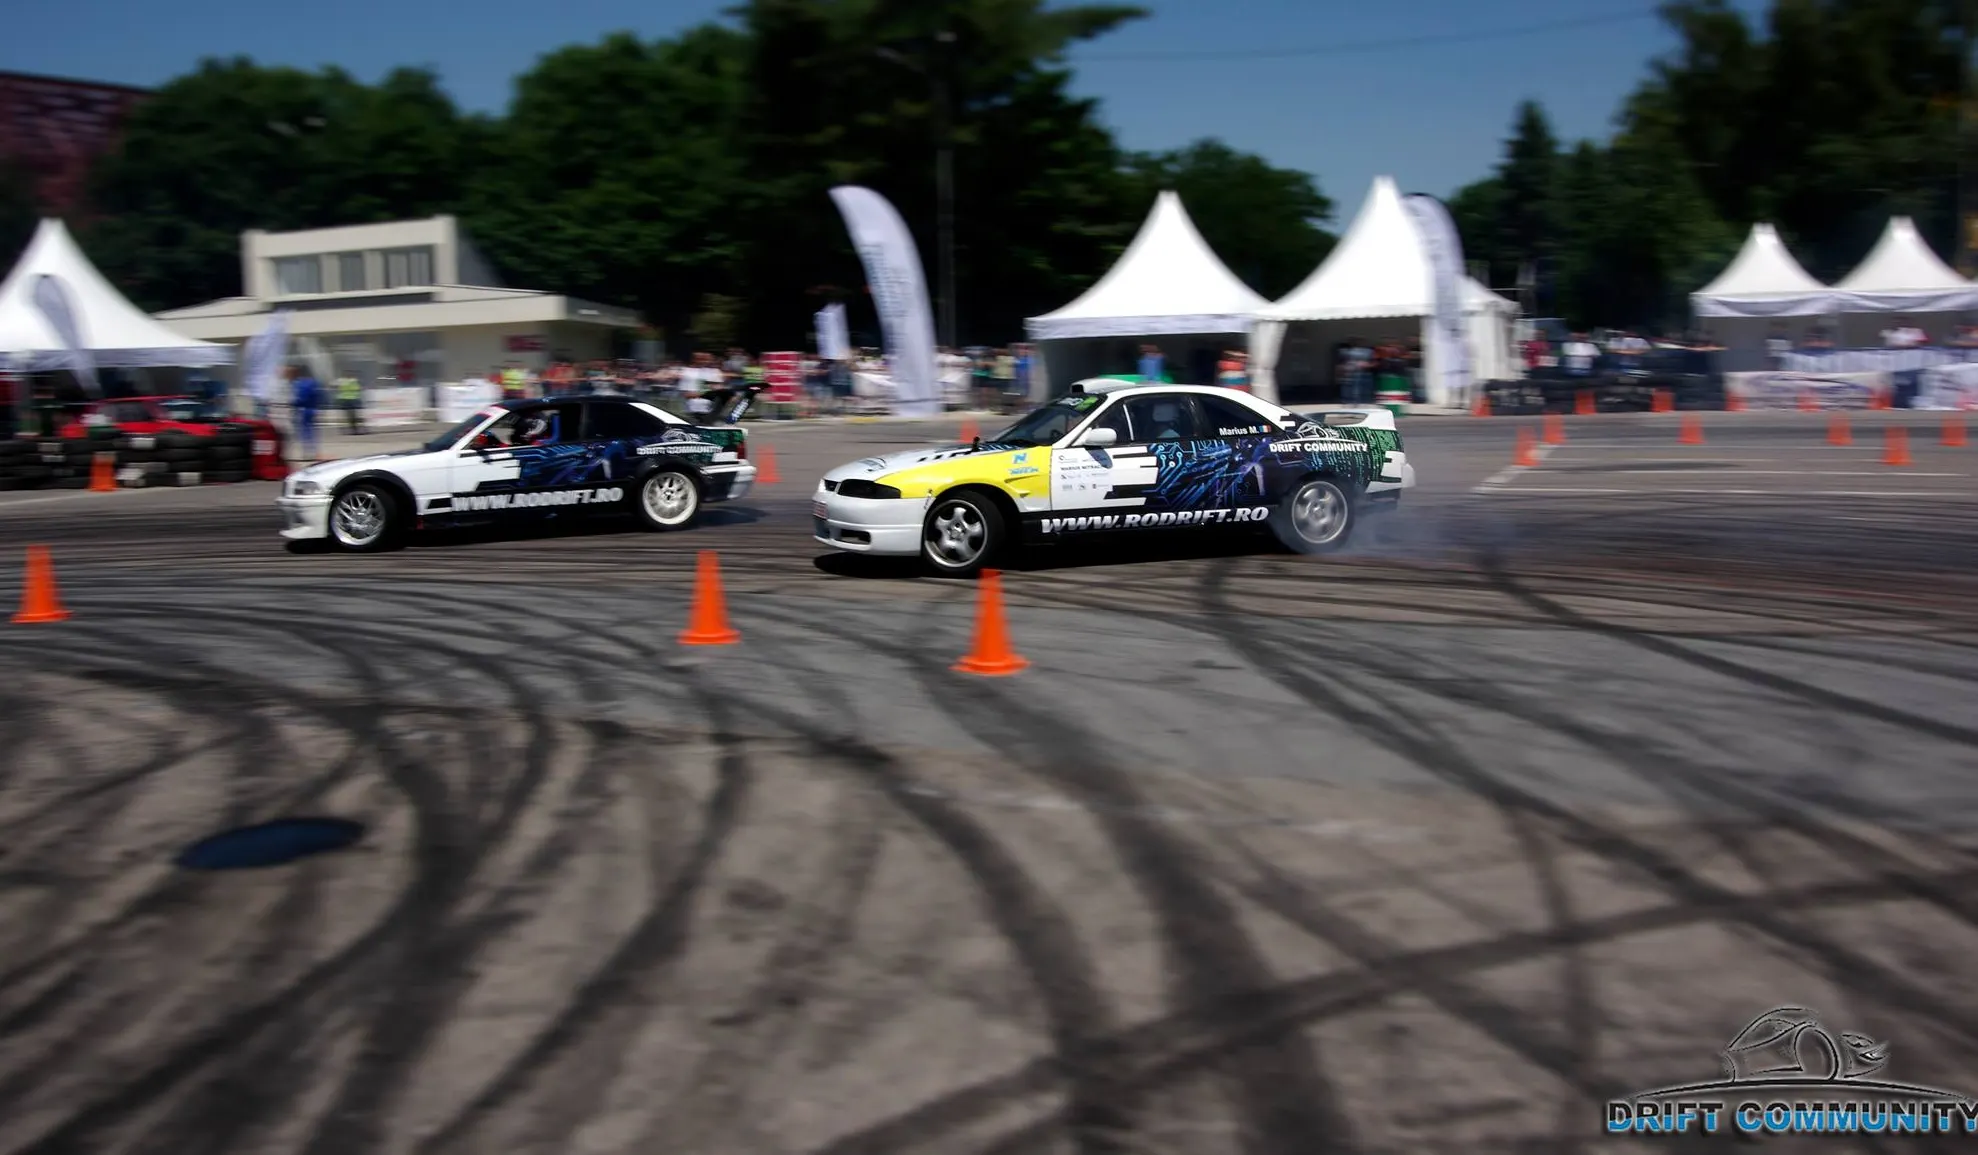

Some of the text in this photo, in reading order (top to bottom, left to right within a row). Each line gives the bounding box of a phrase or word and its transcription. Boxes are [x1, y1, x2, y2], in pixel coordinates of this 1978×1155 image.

[1219, 426, 1260, 436] Marius M.
[637, 446, 665, 455] DRIFT
[1269, 443, 1368, 453] DRIFT COMMUNITY
[452, 486, 624, 512] WWW.RODRIFT.RO
[1041, 506, 1270, 534] WWW.RODRIFT.RO
